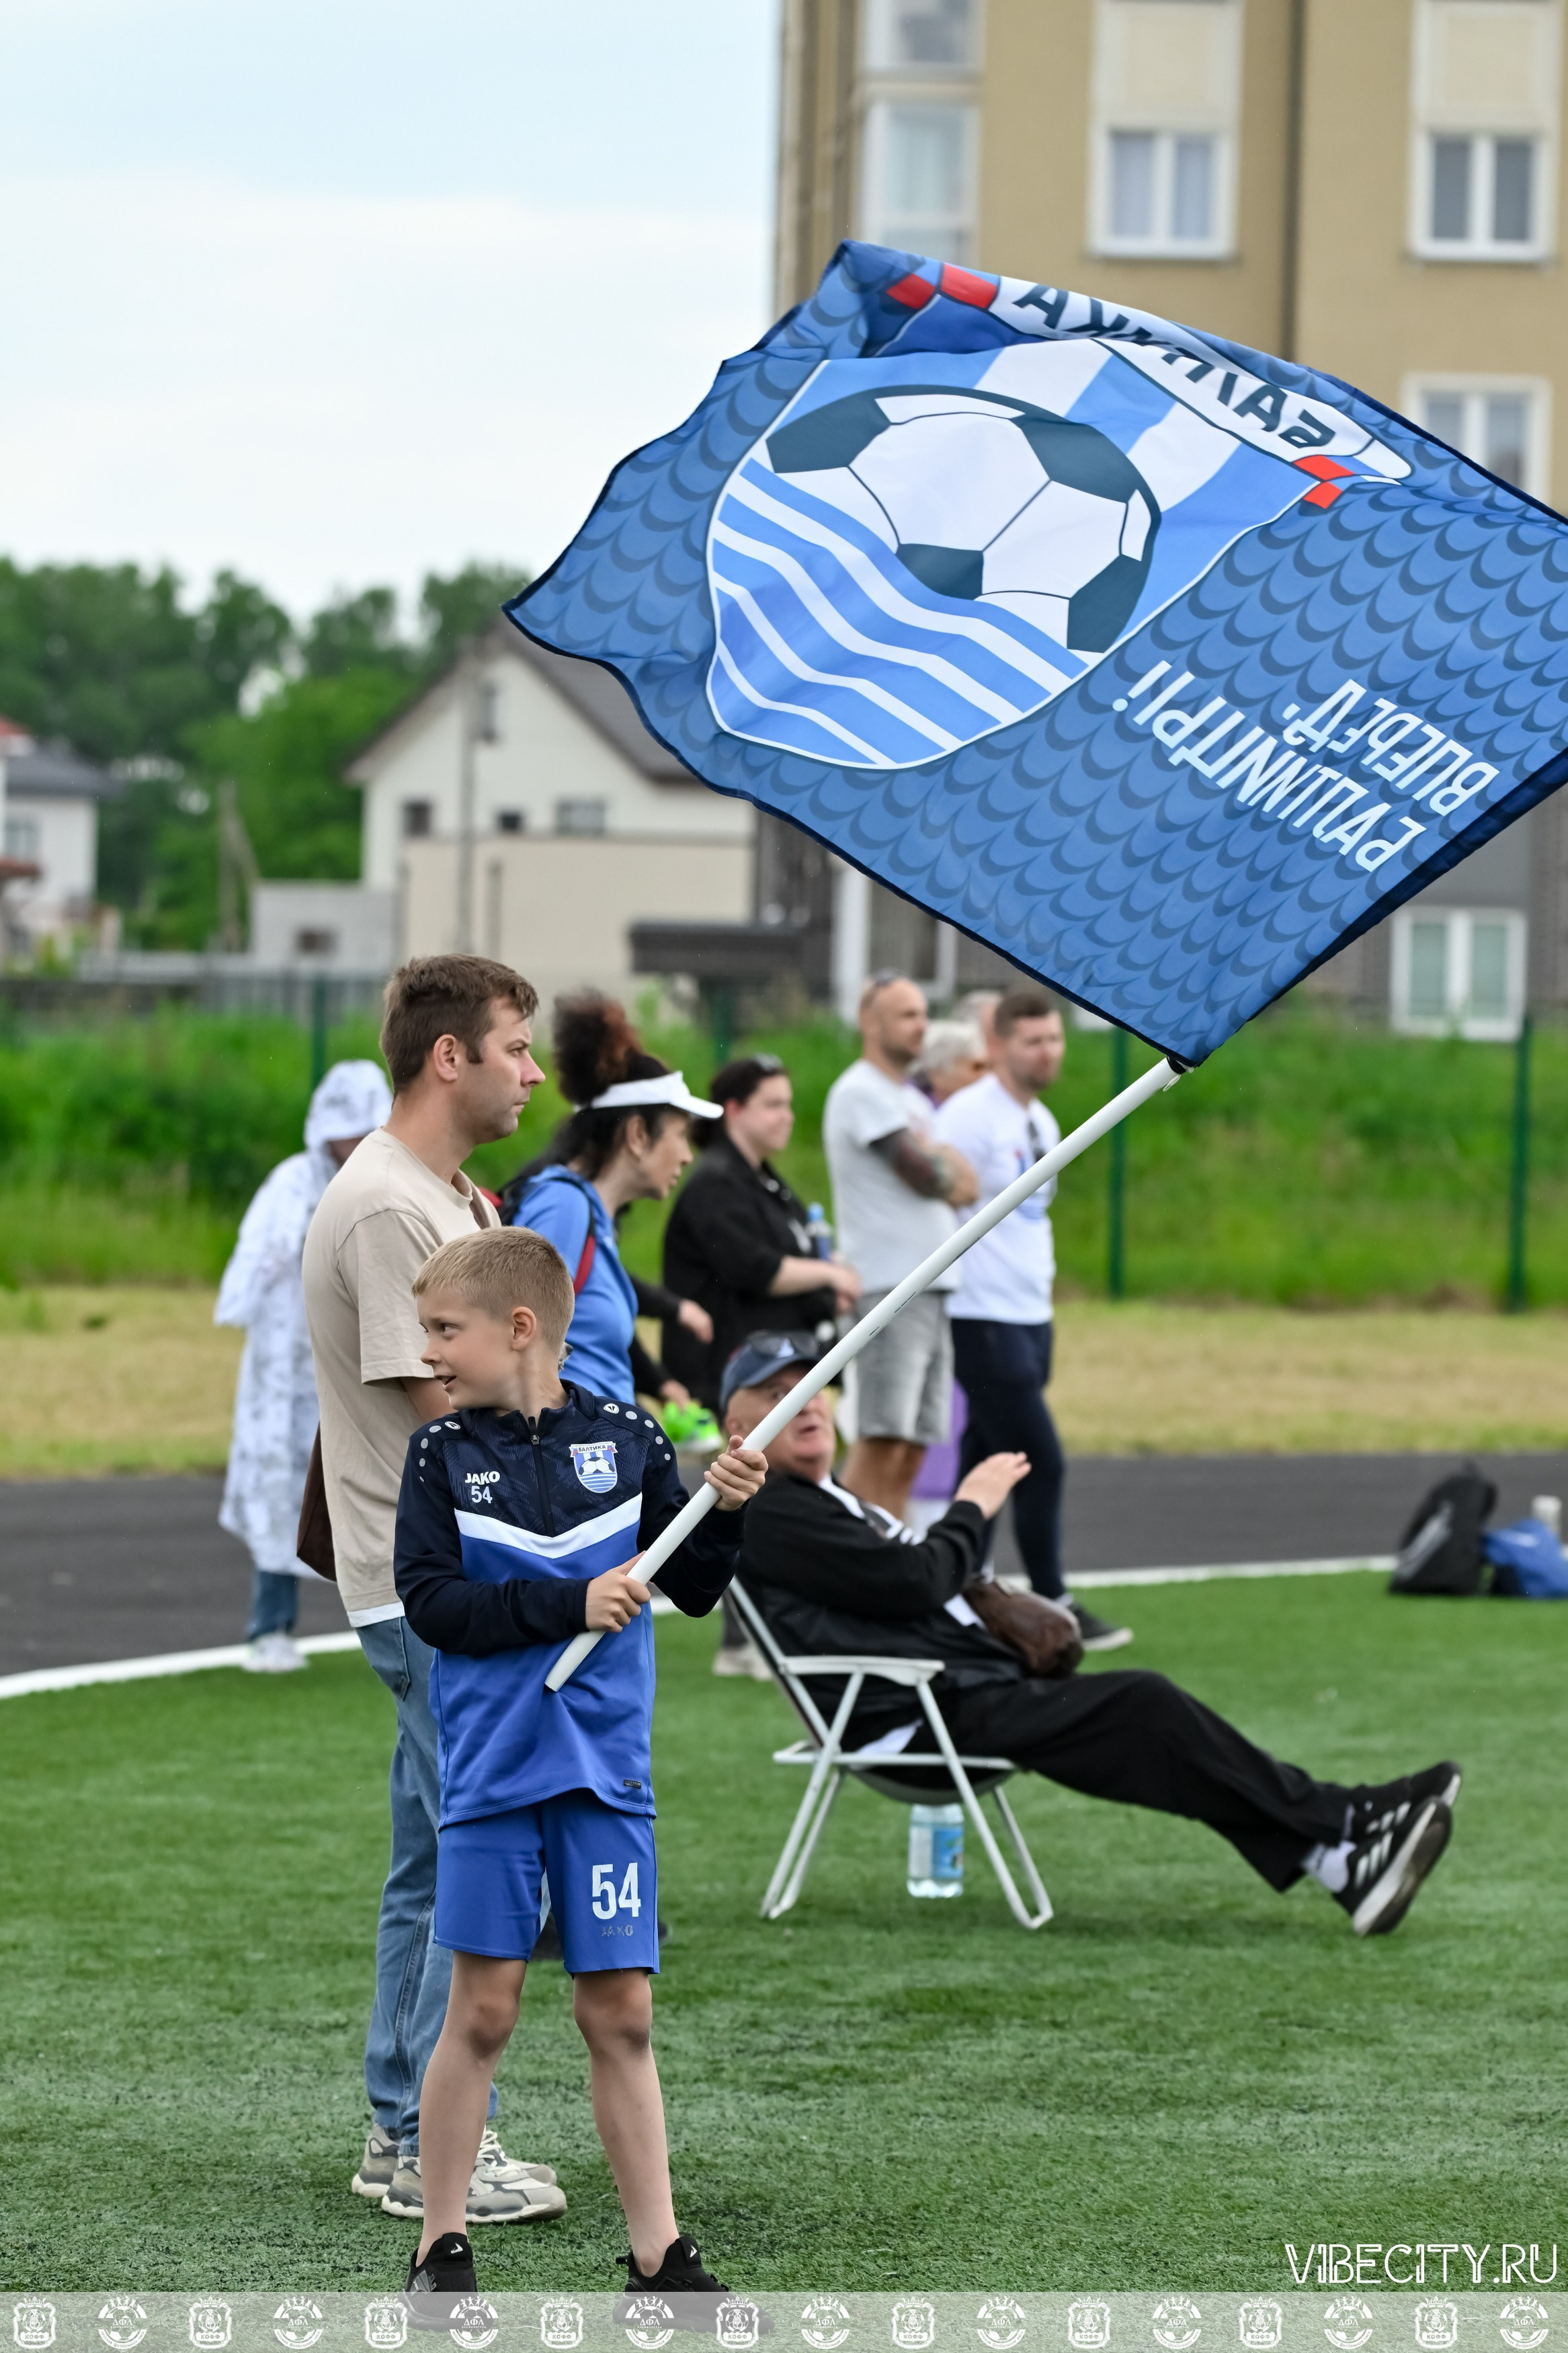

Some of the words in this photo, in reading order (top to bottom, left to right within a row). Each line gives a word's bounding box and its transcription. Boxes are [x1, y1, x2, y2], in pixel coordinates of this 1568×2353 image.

[464, 1470, 501, 1485] JAKO
[471, 1485, 493, 1504] 54
[591, 1862, 641, 1920] 54
[601, 1924, 634, 1937] JAKO
